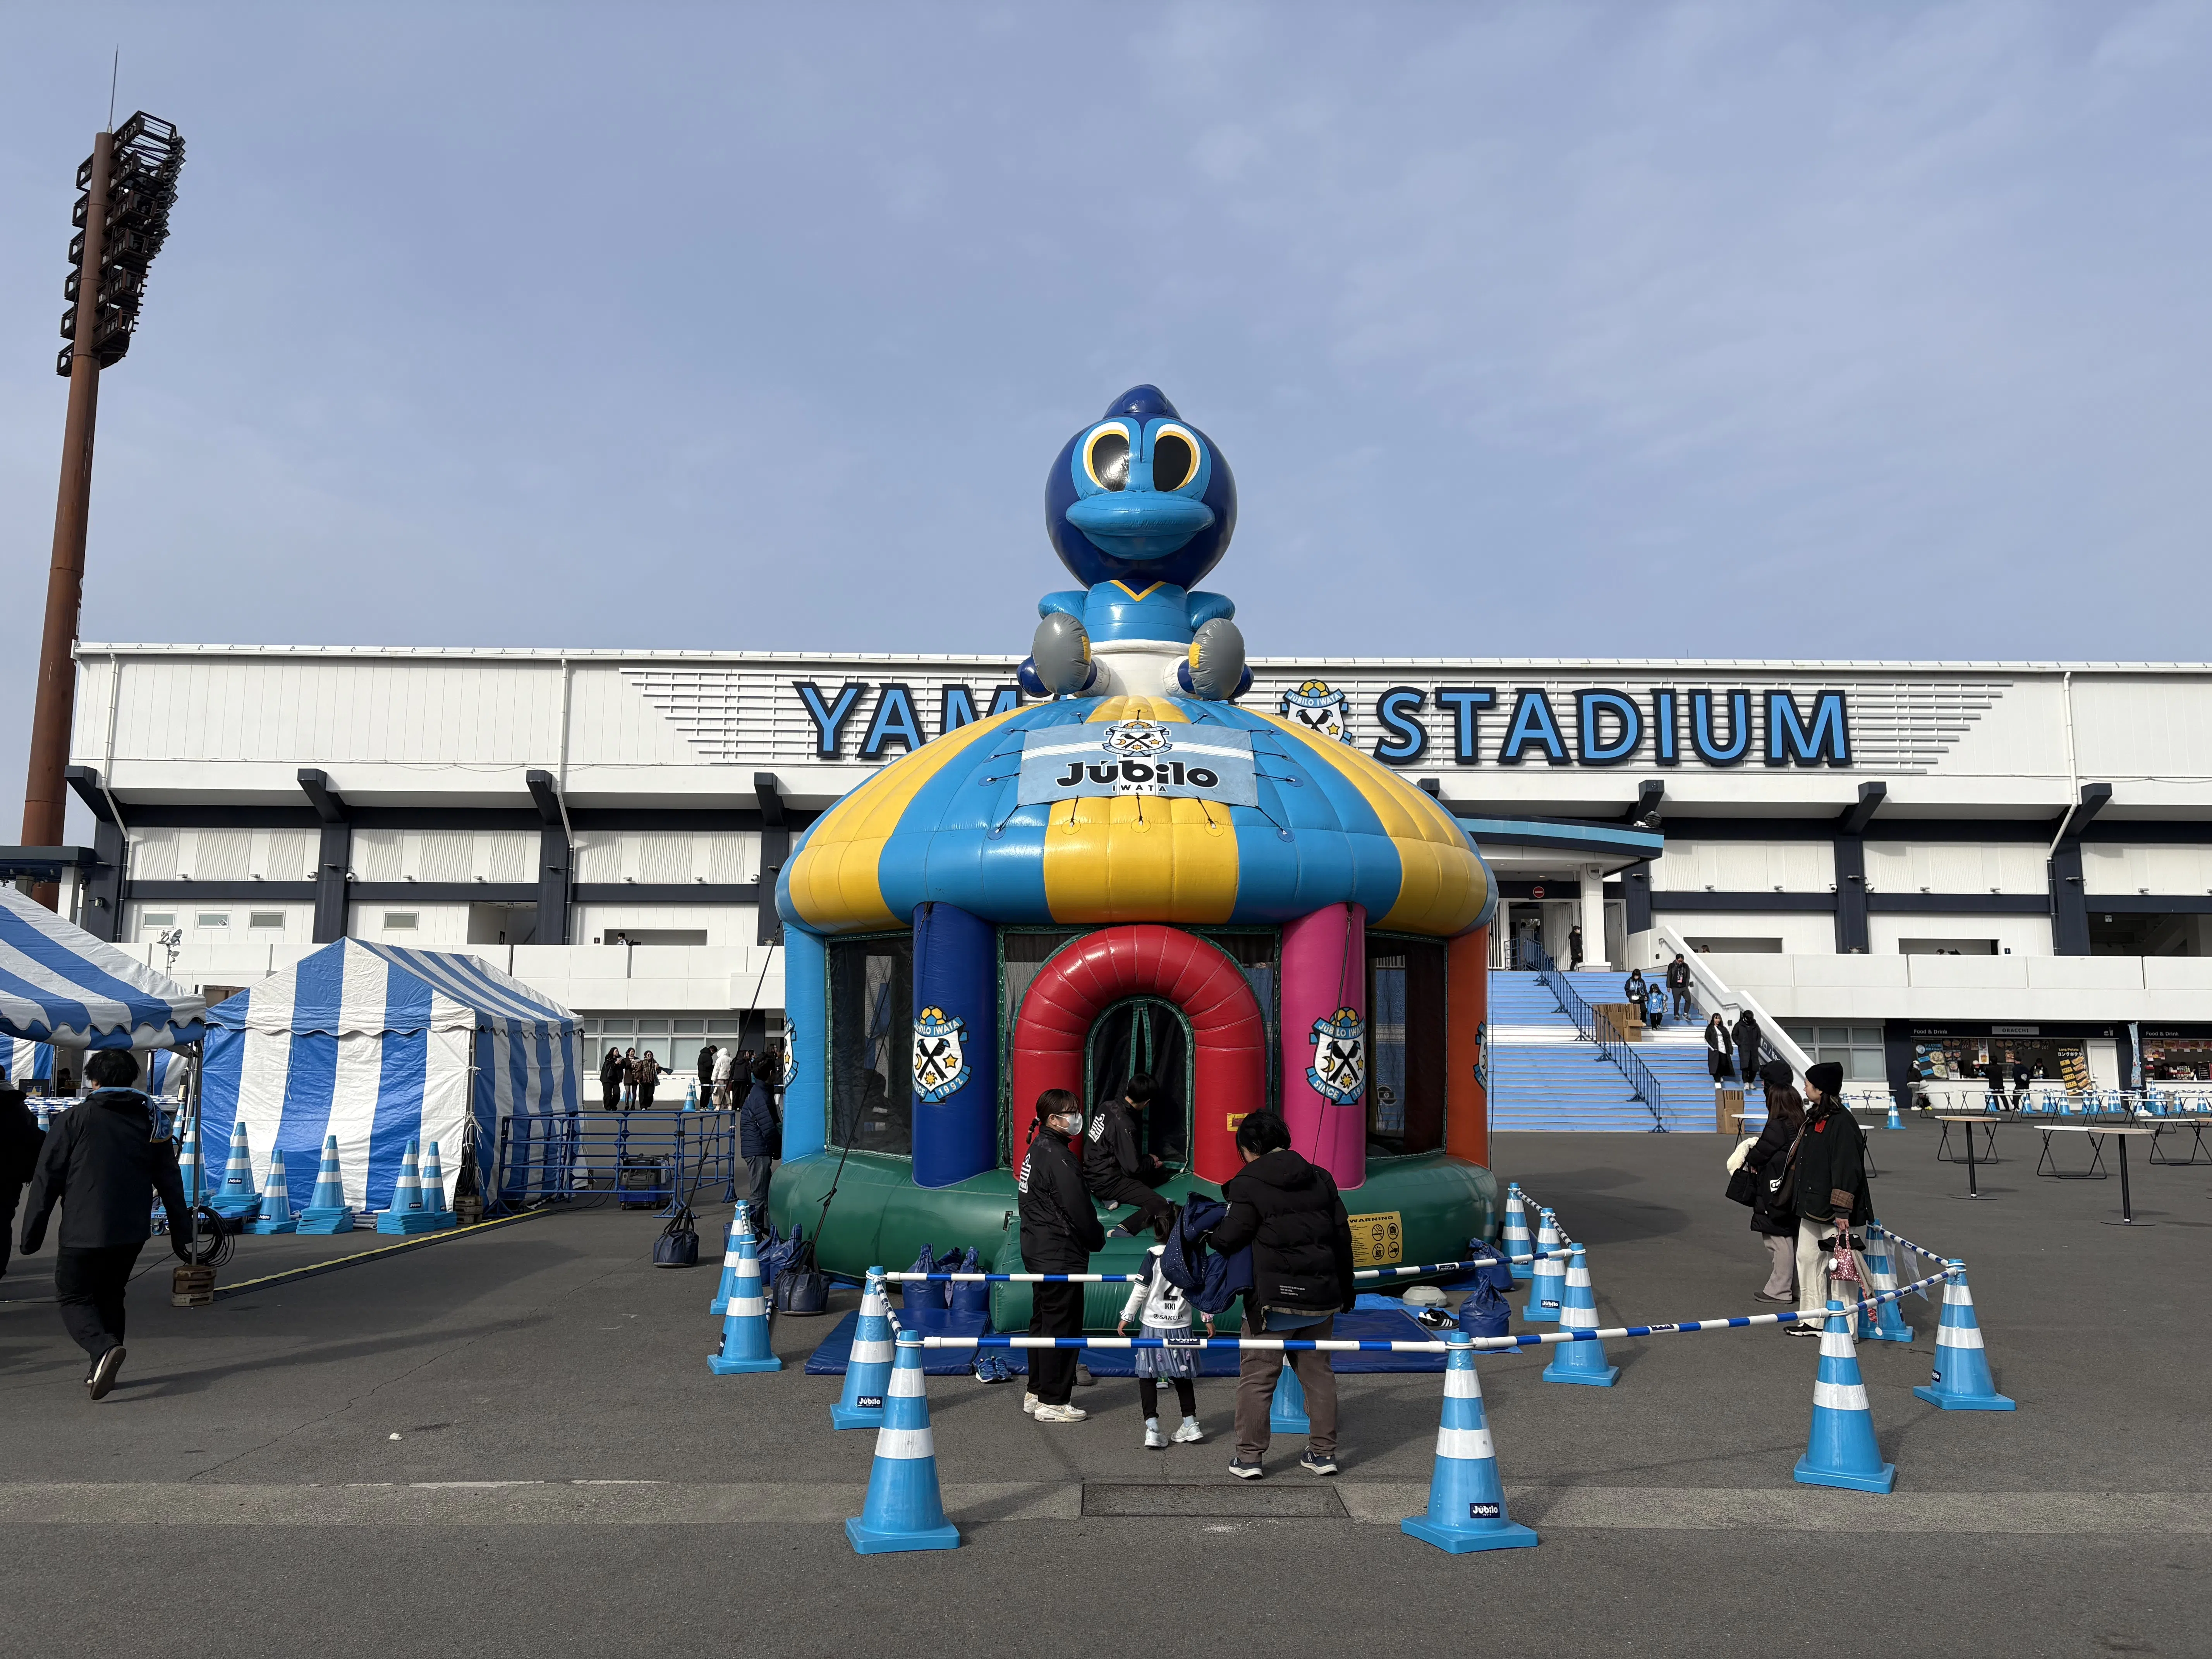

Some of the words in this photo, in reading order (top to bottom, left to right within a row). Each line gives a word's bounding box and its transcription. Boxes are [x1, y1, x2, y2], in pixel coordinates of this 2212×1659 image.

[1317, 693, 1340, 706] IWATA
[1374, 686, 1852, 765] STADIUM
[1056, 760, 1219, 787] Júbilo
[934, 1020, 960, 1035] IWATA
[938, 1078, 963, 1096] 1992
[1314, 1080, 1339, 1099] SINCE
